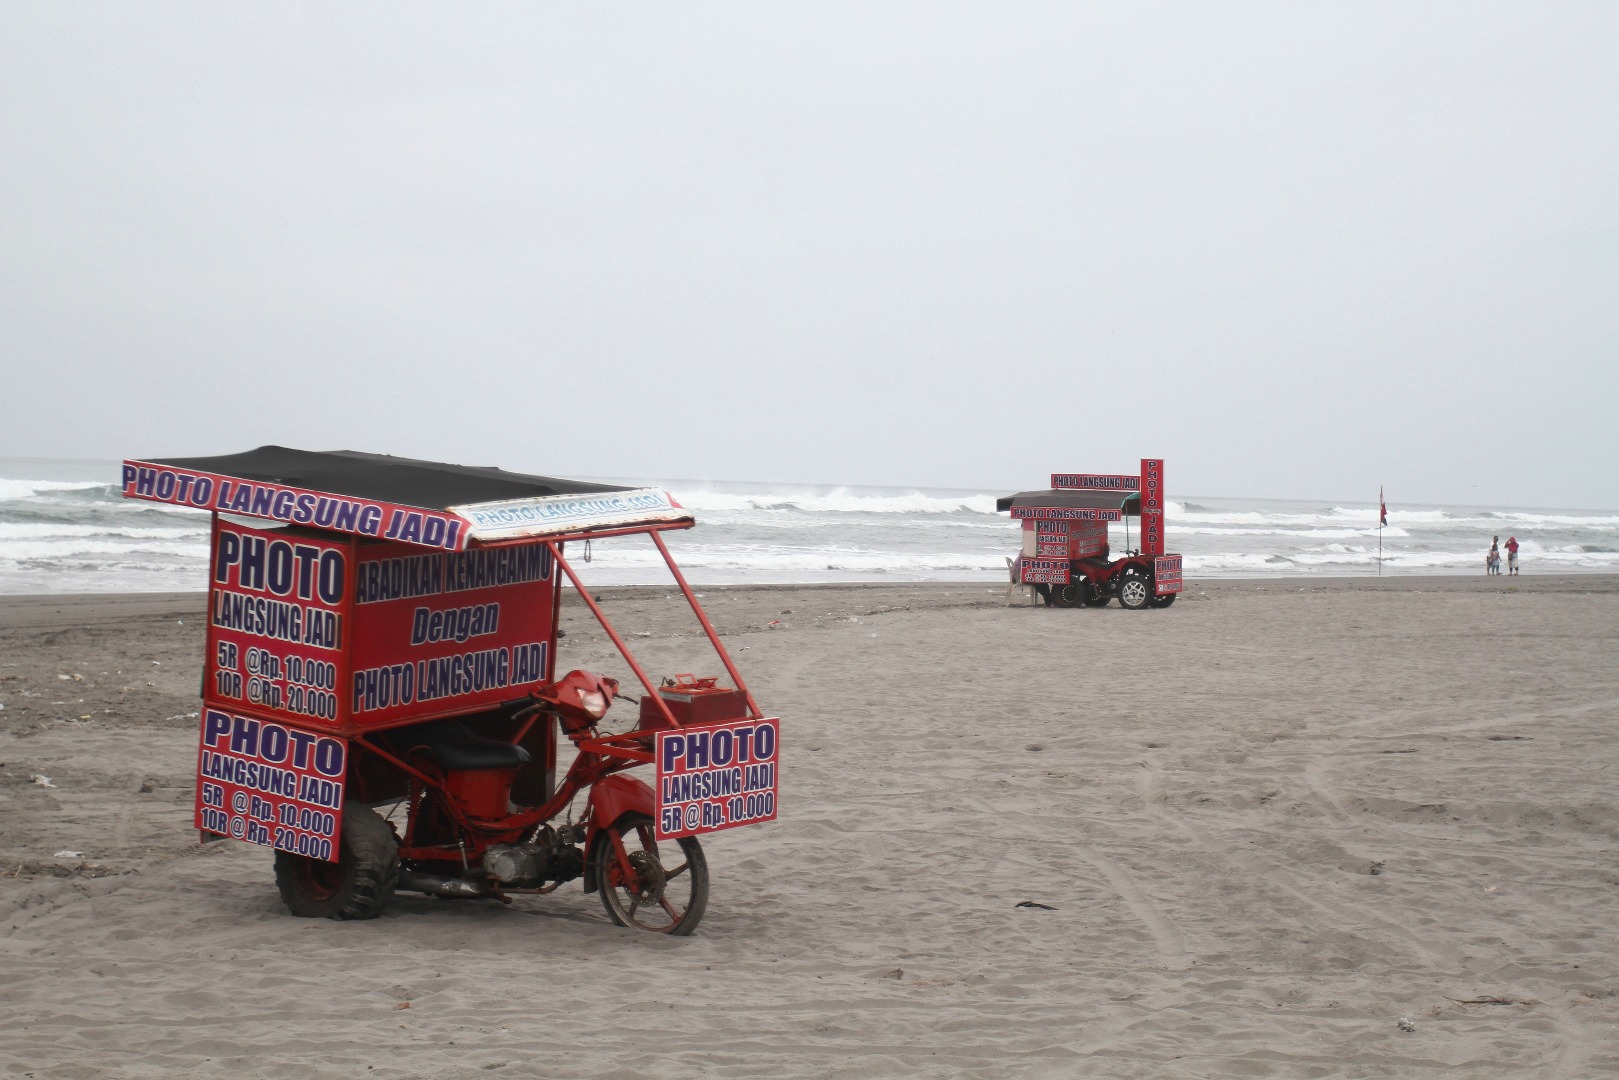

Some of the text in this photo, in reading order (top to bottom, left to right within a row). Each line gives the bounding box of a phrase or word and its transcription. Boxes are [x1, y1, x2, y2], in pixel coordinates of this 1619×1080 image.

[123, 464, 462, 550] PHOTO LANGSUNG JADI
[1053, 475, 1138, 489] PHOTO LANGSUNG JADI
[473, 492, 666, 526] PHOTO LANGSUNG JADI
[1014, 508, 1118, 521] PHOTO LANGSUNG JADI
[1037, 520, 1067, 534] PHOTO
[215, 529, 345, 606] PHOTO
[355, 543, 551, 605] ABADIKAN KENANGANMU
[1021, 560, 1070, 570] PHOTO
[1157, 558, 1182, 572] PHOTO
[212, 588, 342, 651] LANGSUNG JADI
[411, 602, 500, 646] Dengan
[217, 639, 239, 670] 5R
[284, 654, 337, 691] 10.000
[352, 641, 548, 714] PHOTO LANGSUNG JADI
[215, 669, 243, 700] 10R
[287, 685, 337, 721] 20.000
[204, 709, 345, 777] PHOTO
[663, 723, 775, 774] PHOTO
[201, 750, 342, 810] LANGSUNG JADI
[662, 761, 774, 806] LANGSUNG JADI
[201, 807, 228, 834] 10R
[274, 827, 332, 862] 20.000
[202, 782, 224, 808] 5R
[279, 803, 335, 837] 10.000
[661, 805, 682, 834] 5R
[727, 791, 774, 823] 10.000
